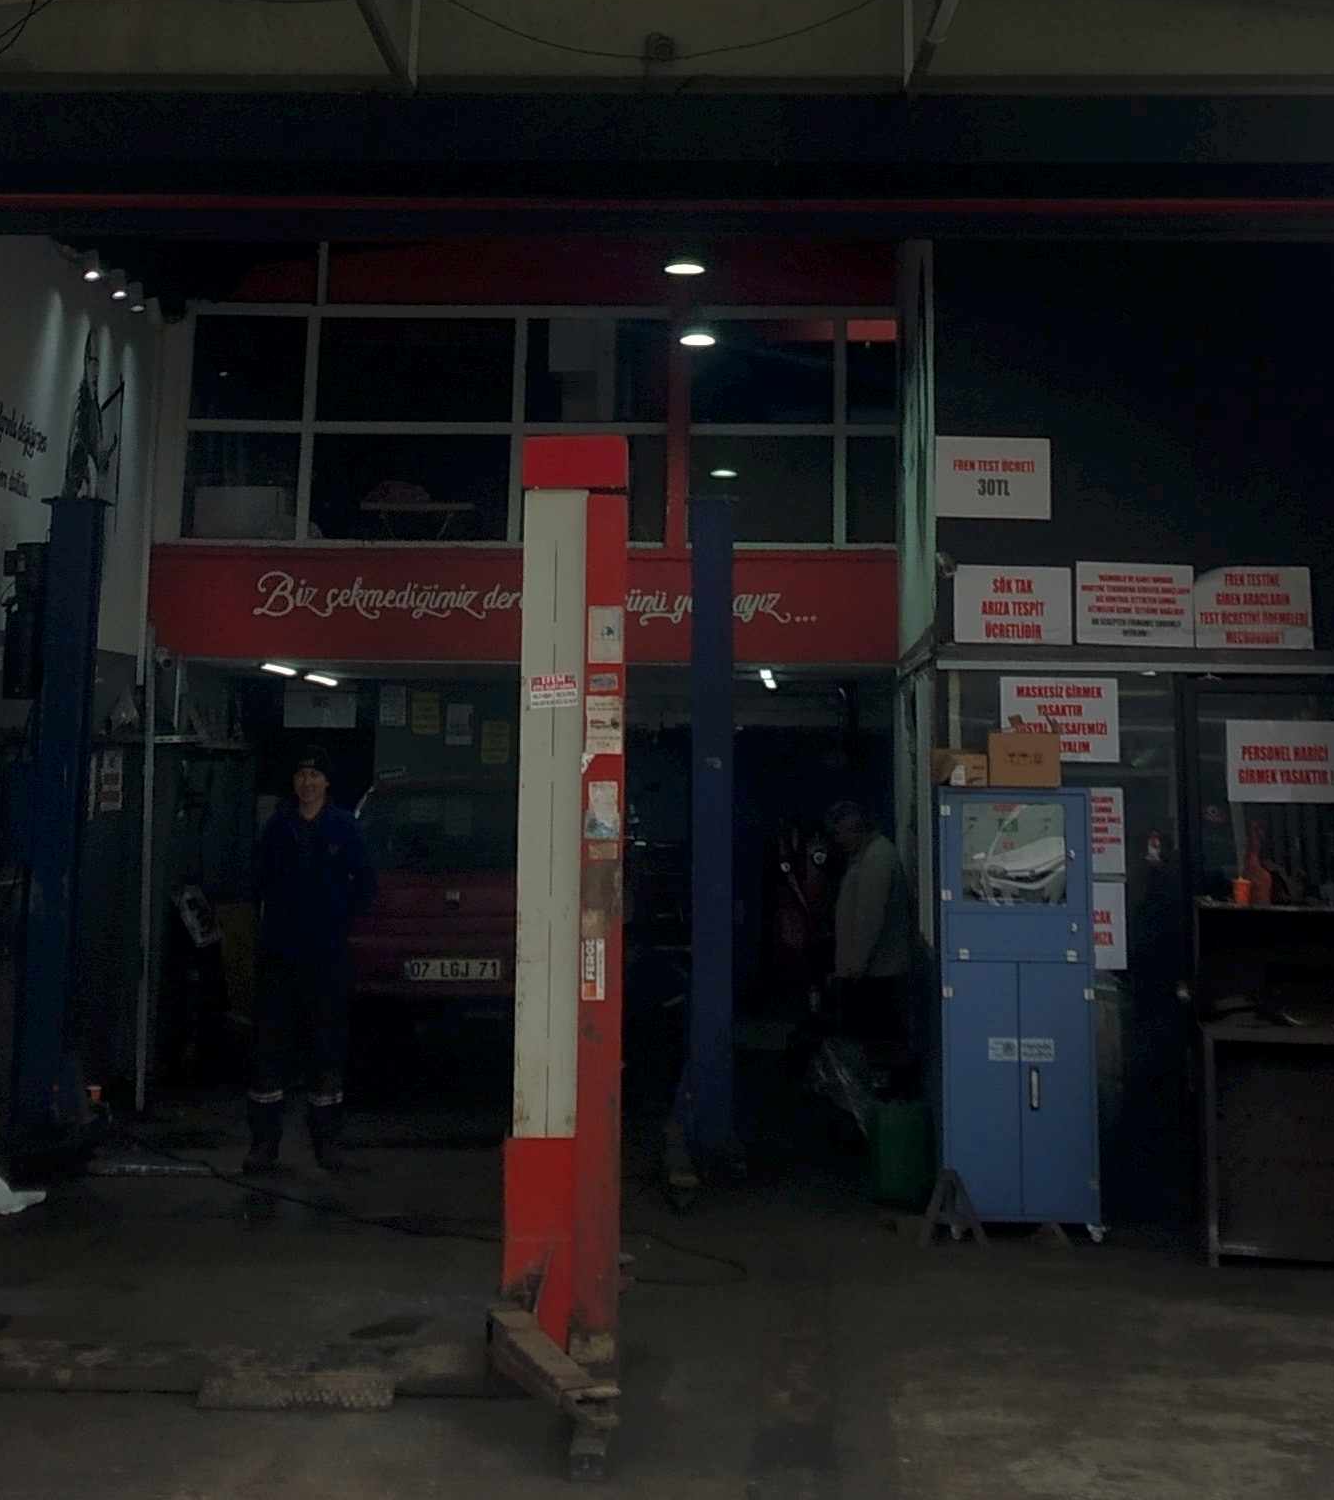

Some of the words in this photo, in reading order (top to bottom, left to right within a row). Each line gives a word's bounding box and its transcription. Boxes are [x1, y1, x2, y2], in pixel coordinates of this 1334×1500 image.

[977, 459, 1000, 473] TEST
[977, 478, 1010, 497] 30TL
[253, 570, 331, 618] Biz
[323, 575, 487, 620] çekmediğimiz
[1014, 578, 1033, 594] TAK
[1012, 599, 1044, 617] TESPİT
